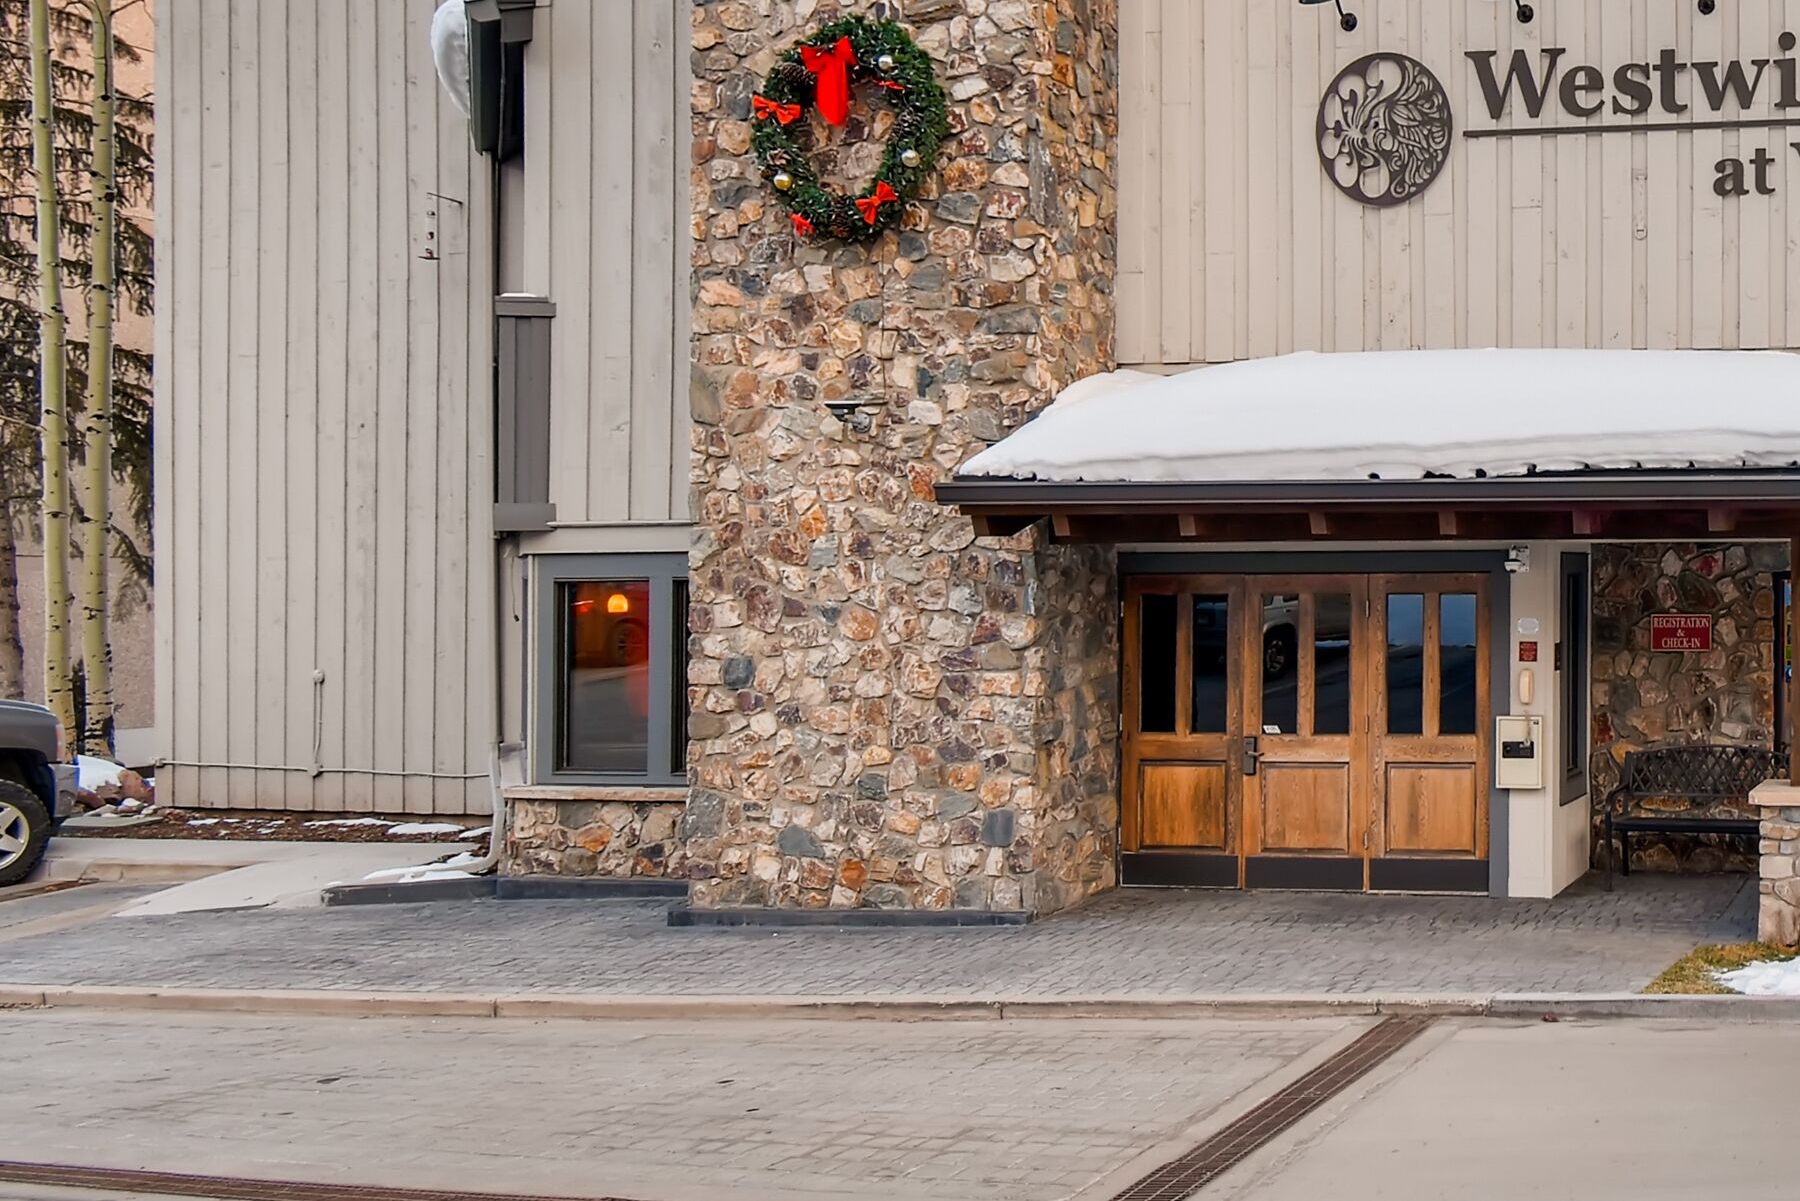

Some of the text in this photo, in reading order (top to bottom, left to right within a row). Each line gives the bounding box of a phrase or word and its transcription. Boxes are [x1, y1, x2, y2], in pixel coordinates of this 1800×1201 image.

[1712, 147, 1776, 199] at
[1653, 617, 1709, 628] REGISTRATION
[1676, 629, 1685, 637] &
[1661, 637, 1701, 648] CHECK-IN
